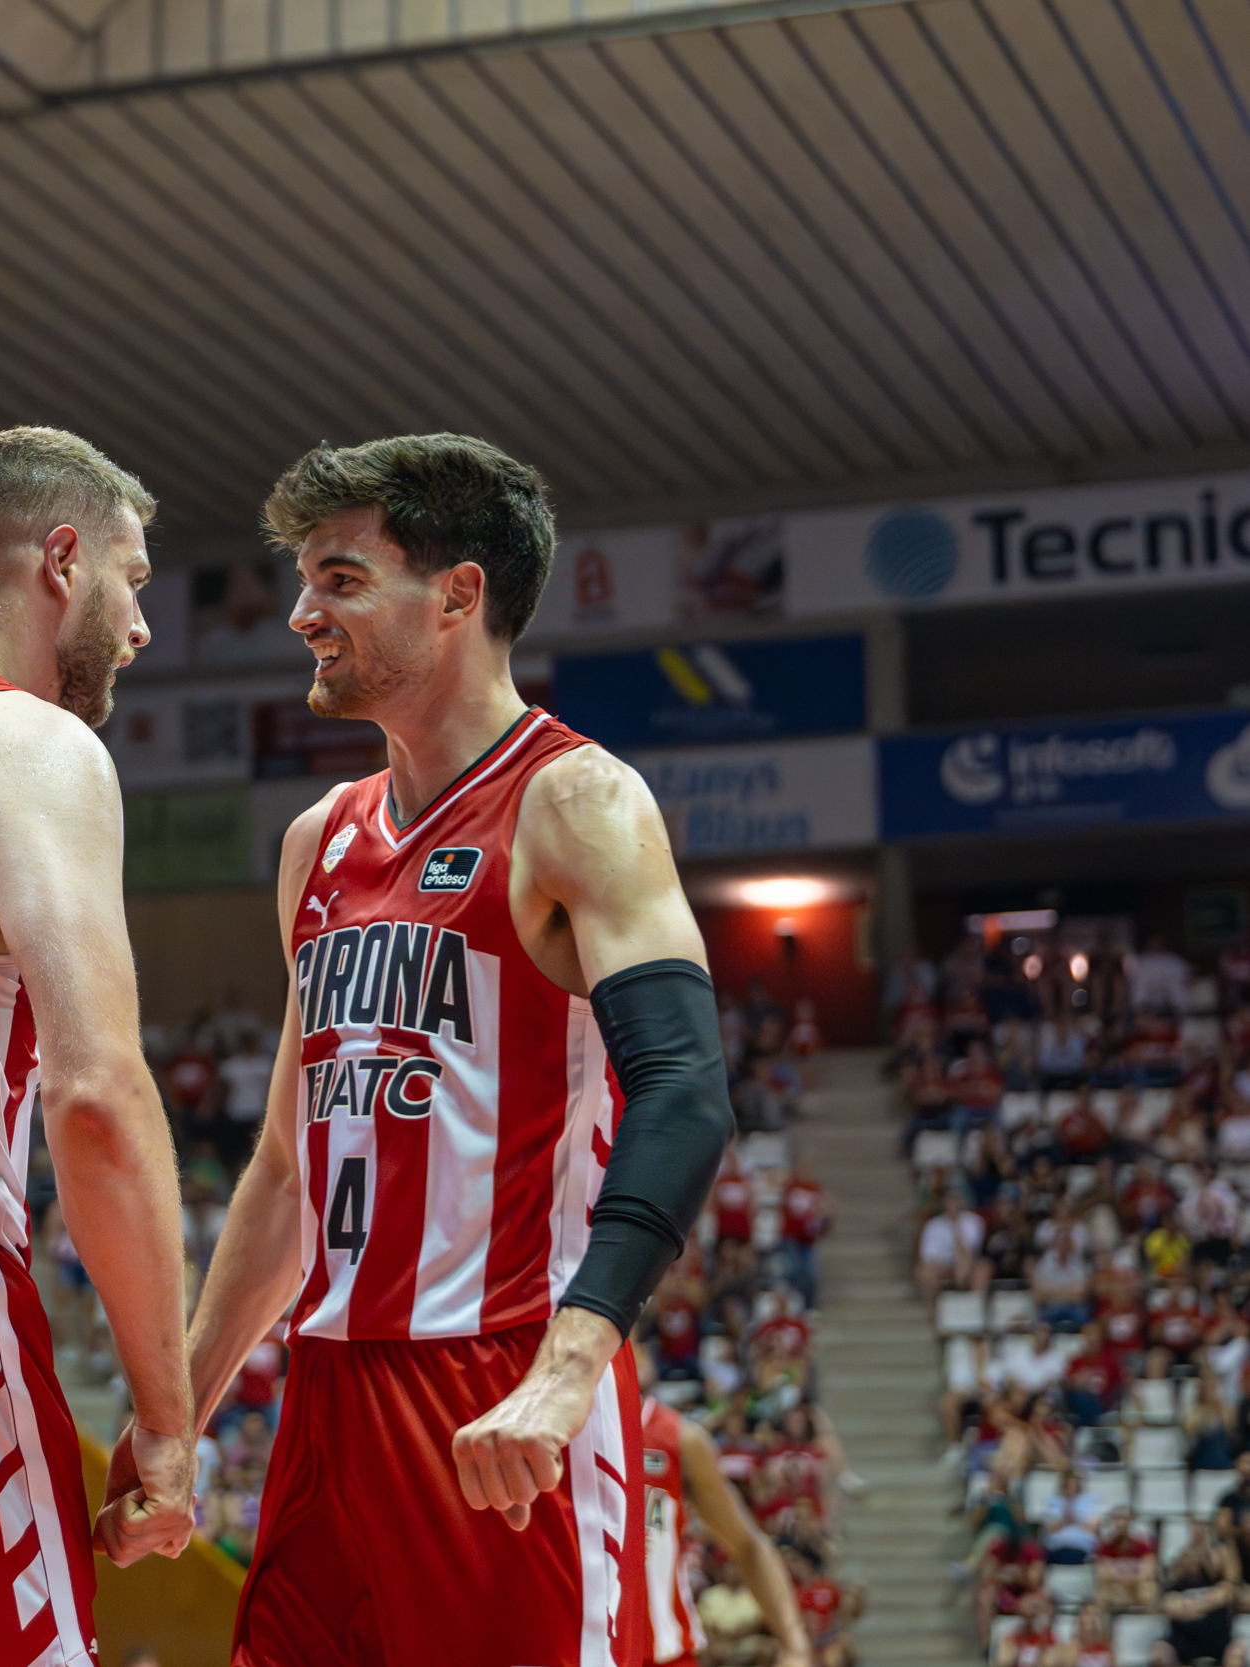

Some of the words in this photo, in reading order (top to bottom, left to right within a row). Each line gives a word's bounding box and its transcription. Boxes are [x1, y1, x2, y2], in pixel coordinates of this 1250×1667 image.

[424, 872, 468, 886] endesa
[427, 861, 450, 876] liga
[296, 920, 476, 1048] GIRONA
[326, 1157, 367, 1266] 4
